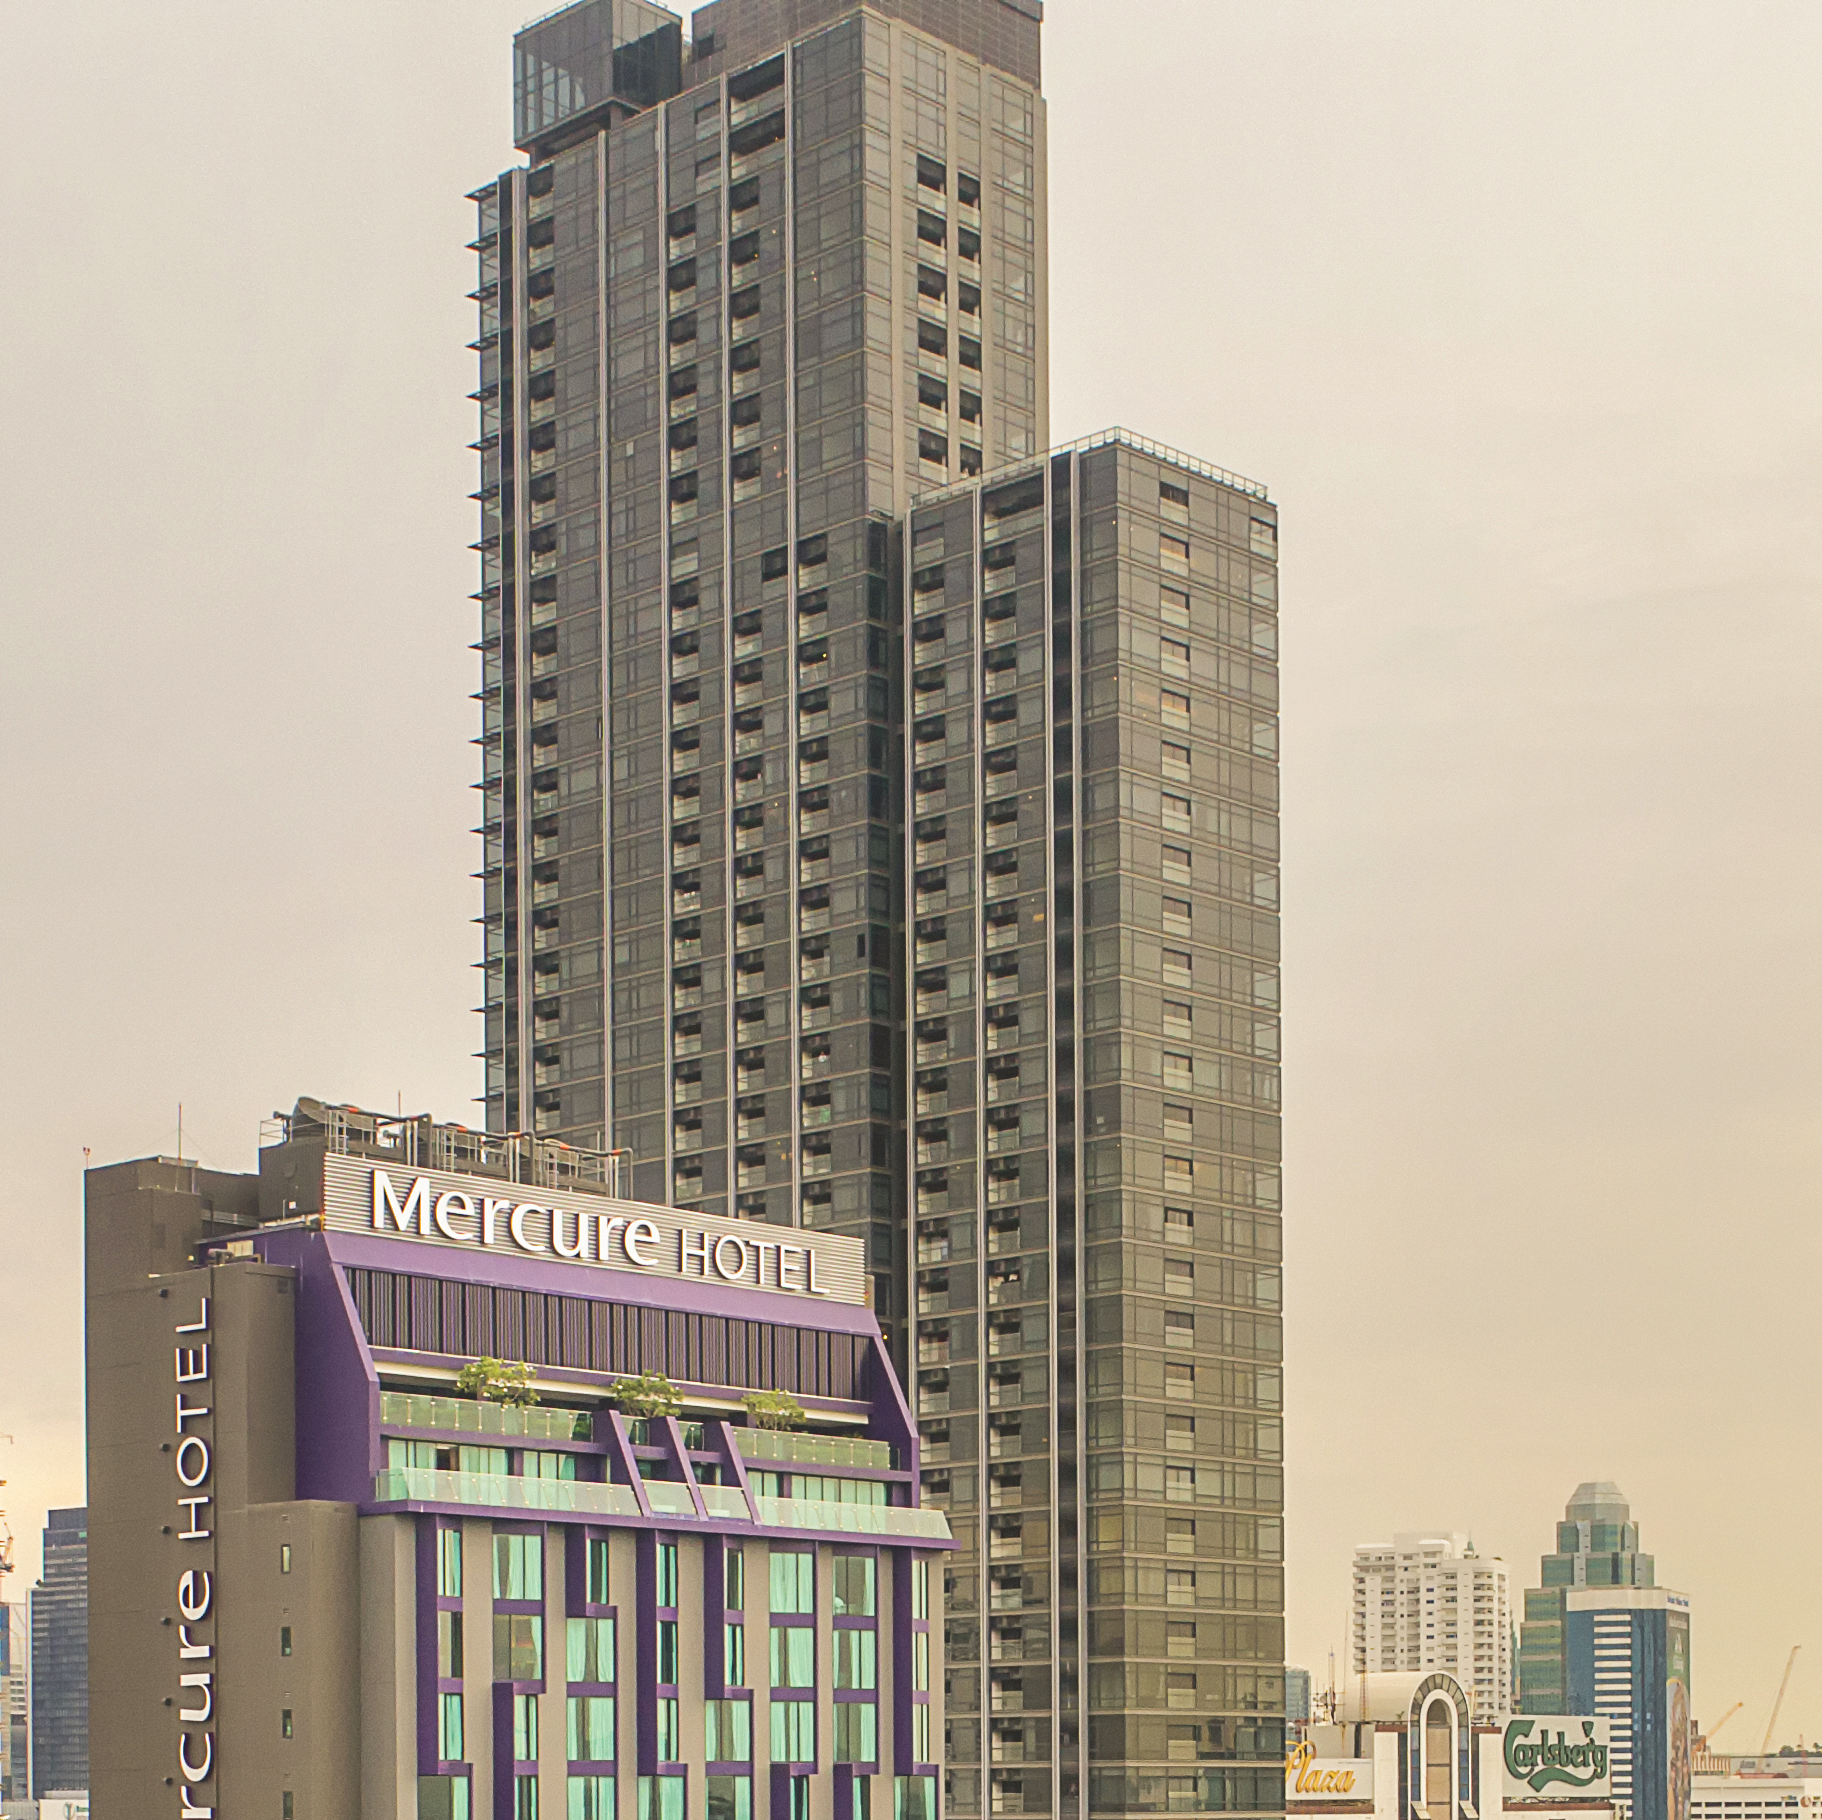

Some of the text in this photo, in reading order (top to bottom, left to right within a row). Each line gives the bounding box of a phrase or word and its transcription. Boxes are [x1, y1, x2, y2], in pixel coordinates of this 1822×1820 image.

[371, 1168, 831, 1295] Mercure HOTEL
[175, 1297, 212, 1540] HOTEL
[1285, 1740, 1356, 1793] Plaza
[1503, 1719, 1609, 1793] Carlsberg
